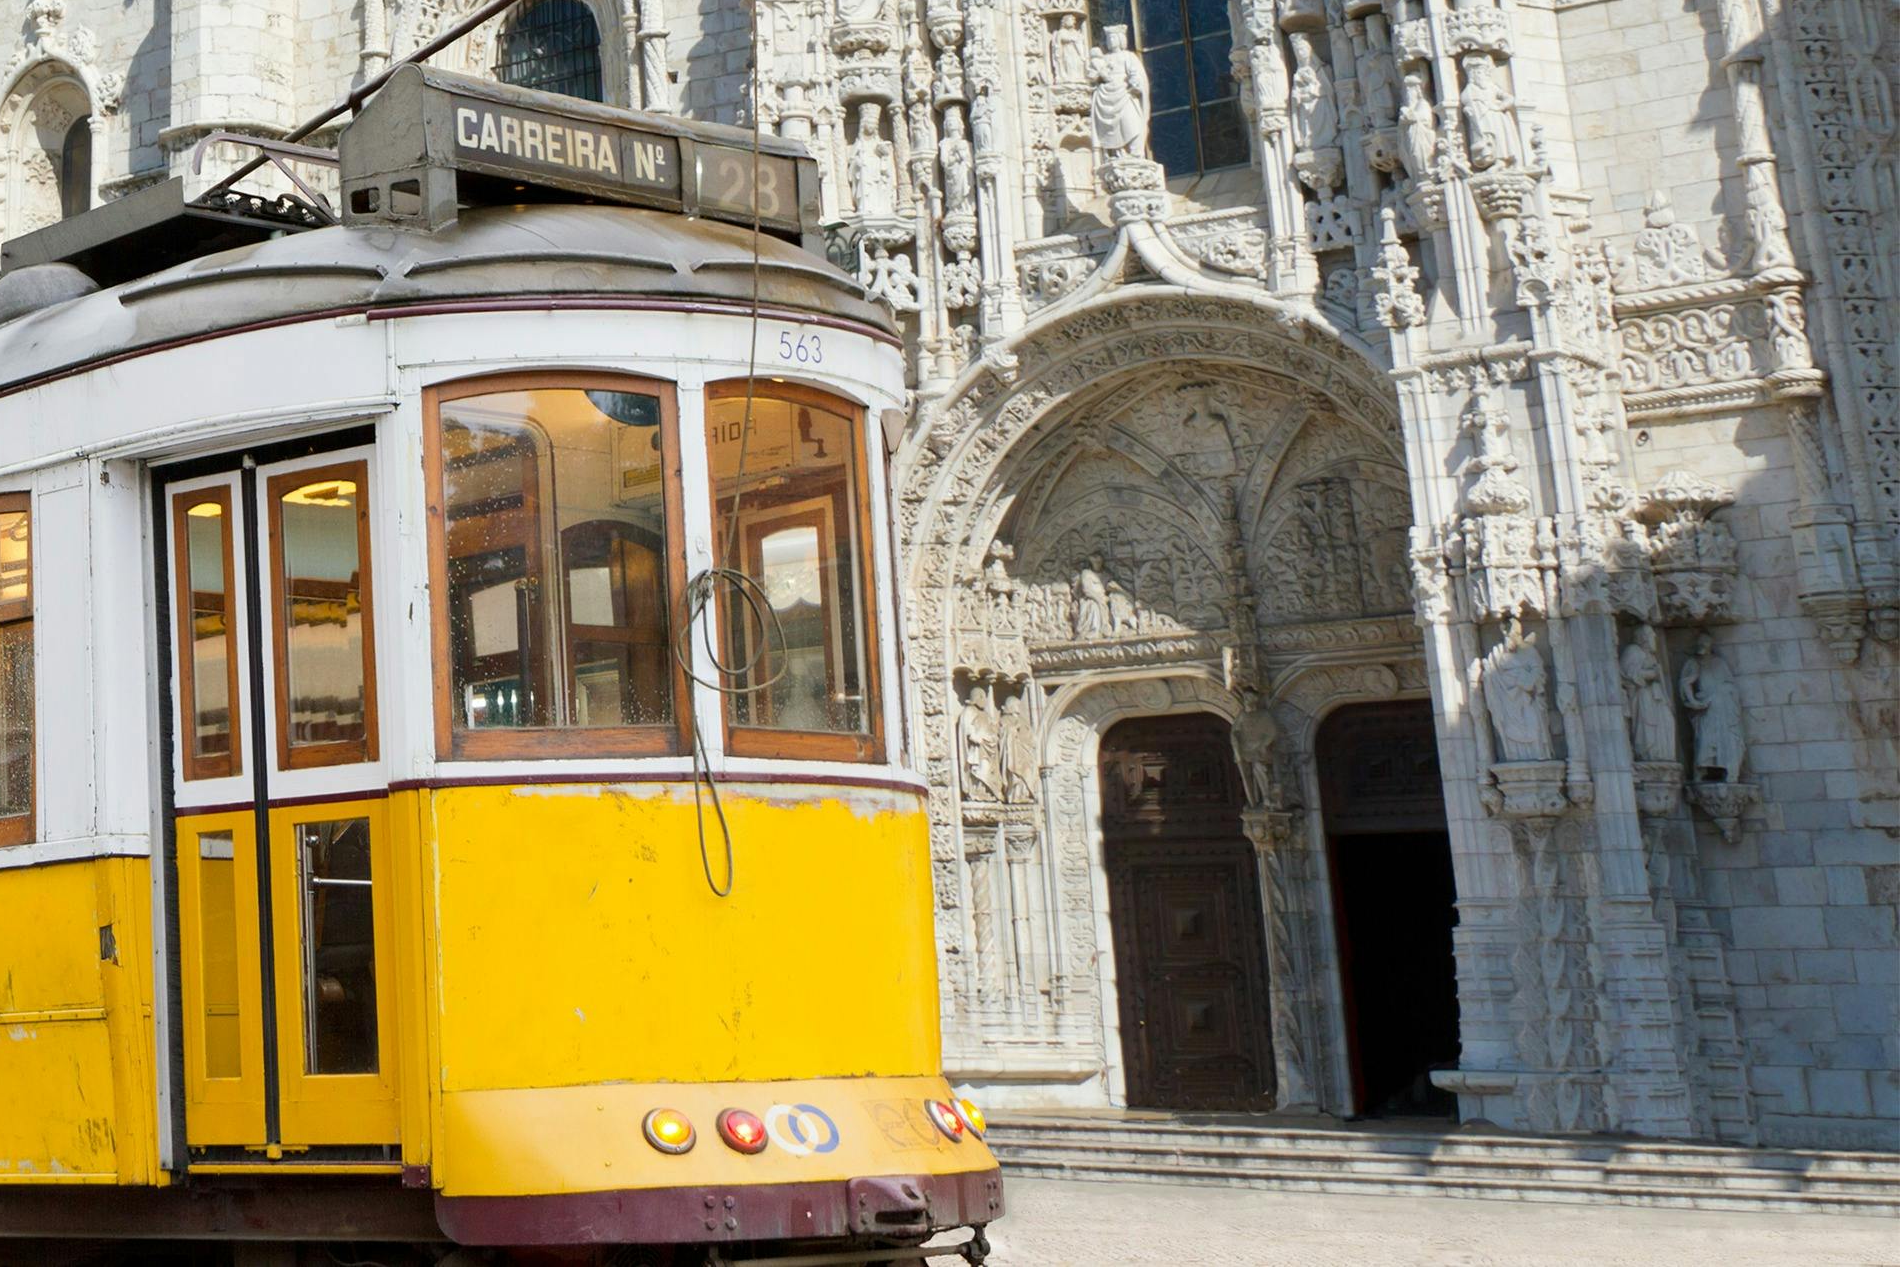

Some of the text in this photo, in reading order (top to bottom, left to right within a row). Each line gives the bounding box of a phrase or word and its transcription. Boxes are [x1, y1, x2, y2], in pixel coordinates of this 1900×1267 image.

[457, 107, 618, 175] CARREIRA
[719, 158, 780, 217] 28
[779, 330, 822, 364] 563
